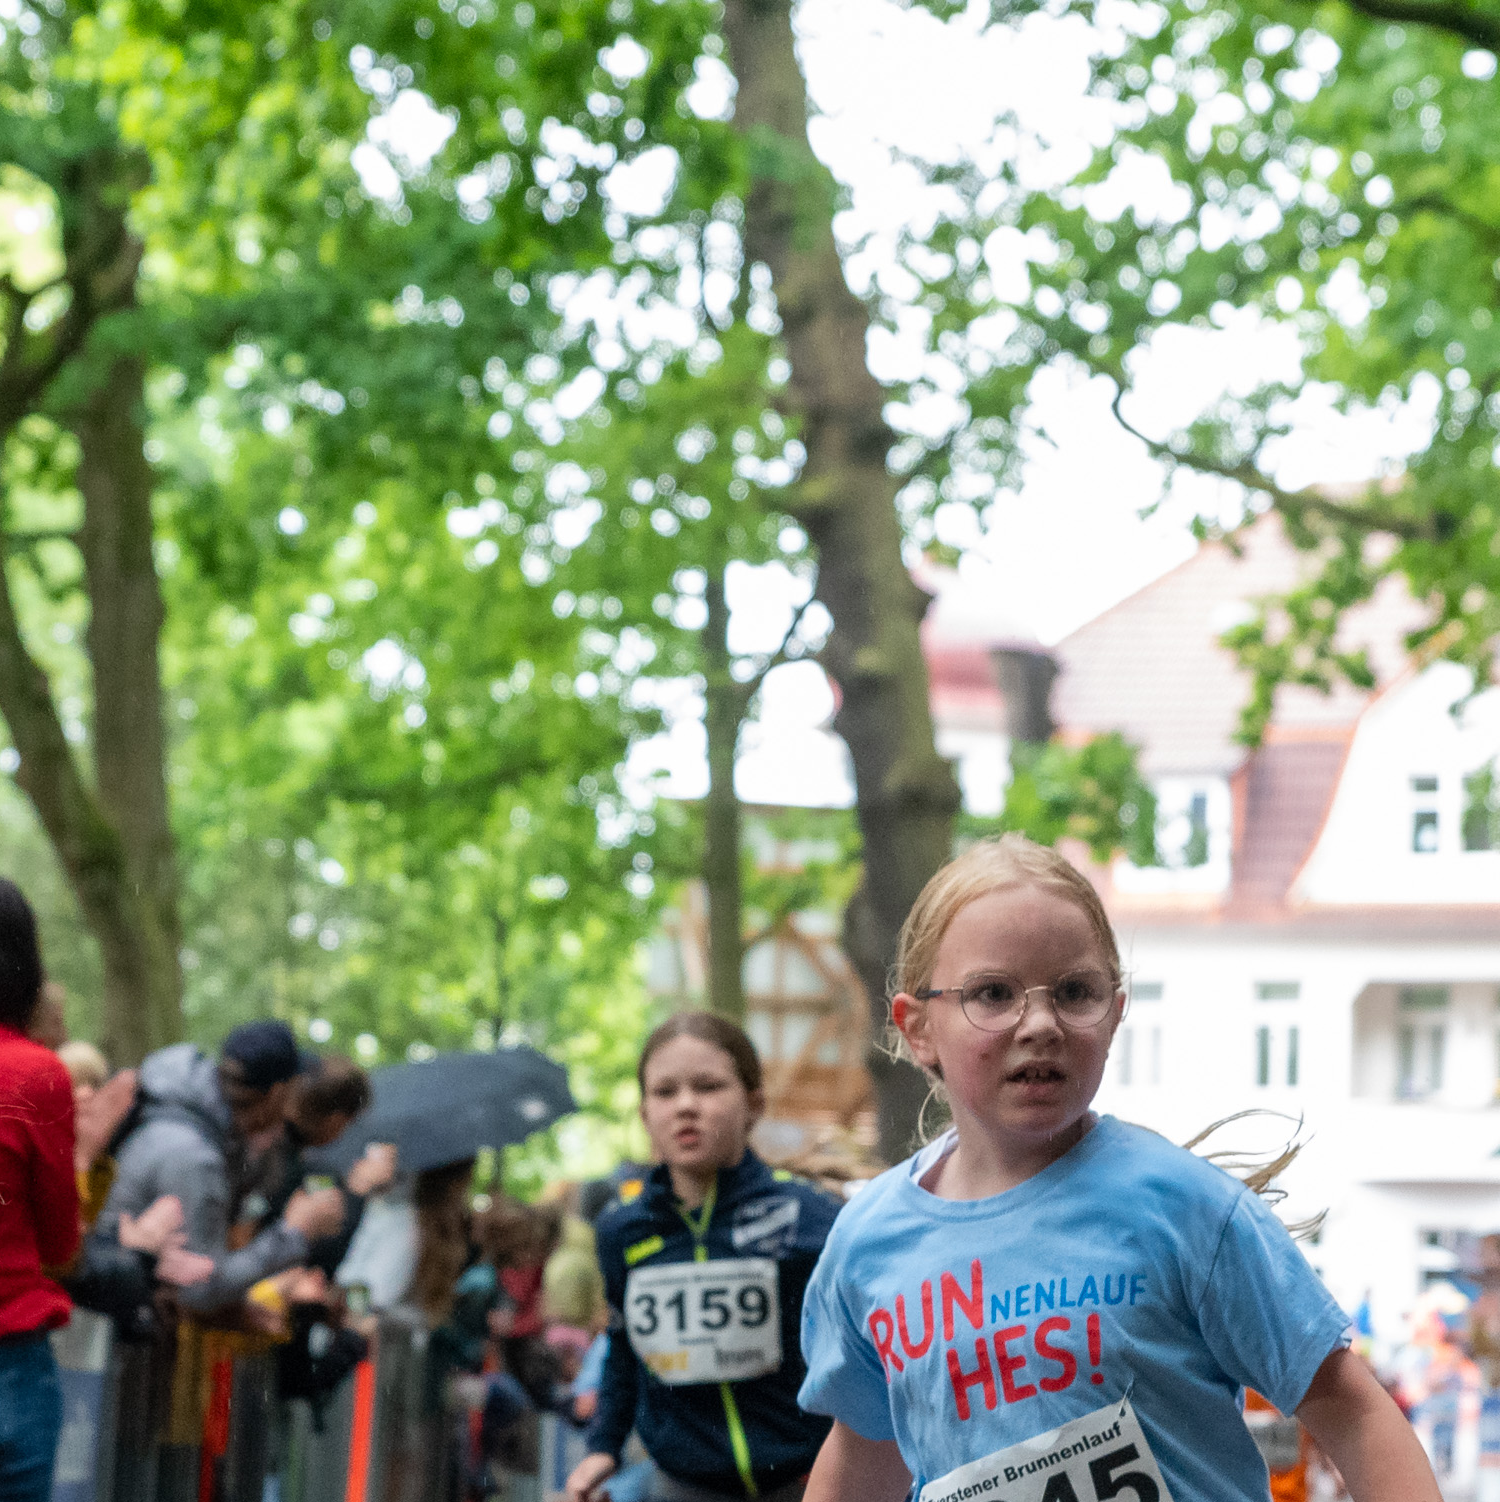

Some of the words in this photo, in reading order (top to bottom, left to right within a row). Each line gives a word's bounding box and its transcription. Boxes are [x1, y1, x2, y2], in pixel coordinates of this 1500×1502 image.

[633, 1284, 769, 1336] 3159
[868, 1258, 984, 1385] RUN
[990, 1273, 1148, 1324] NENLAUF
[946, 1312, 1105, 1421] HES!
[1003, 1420, 1123, 1484] Brunnenlauf
